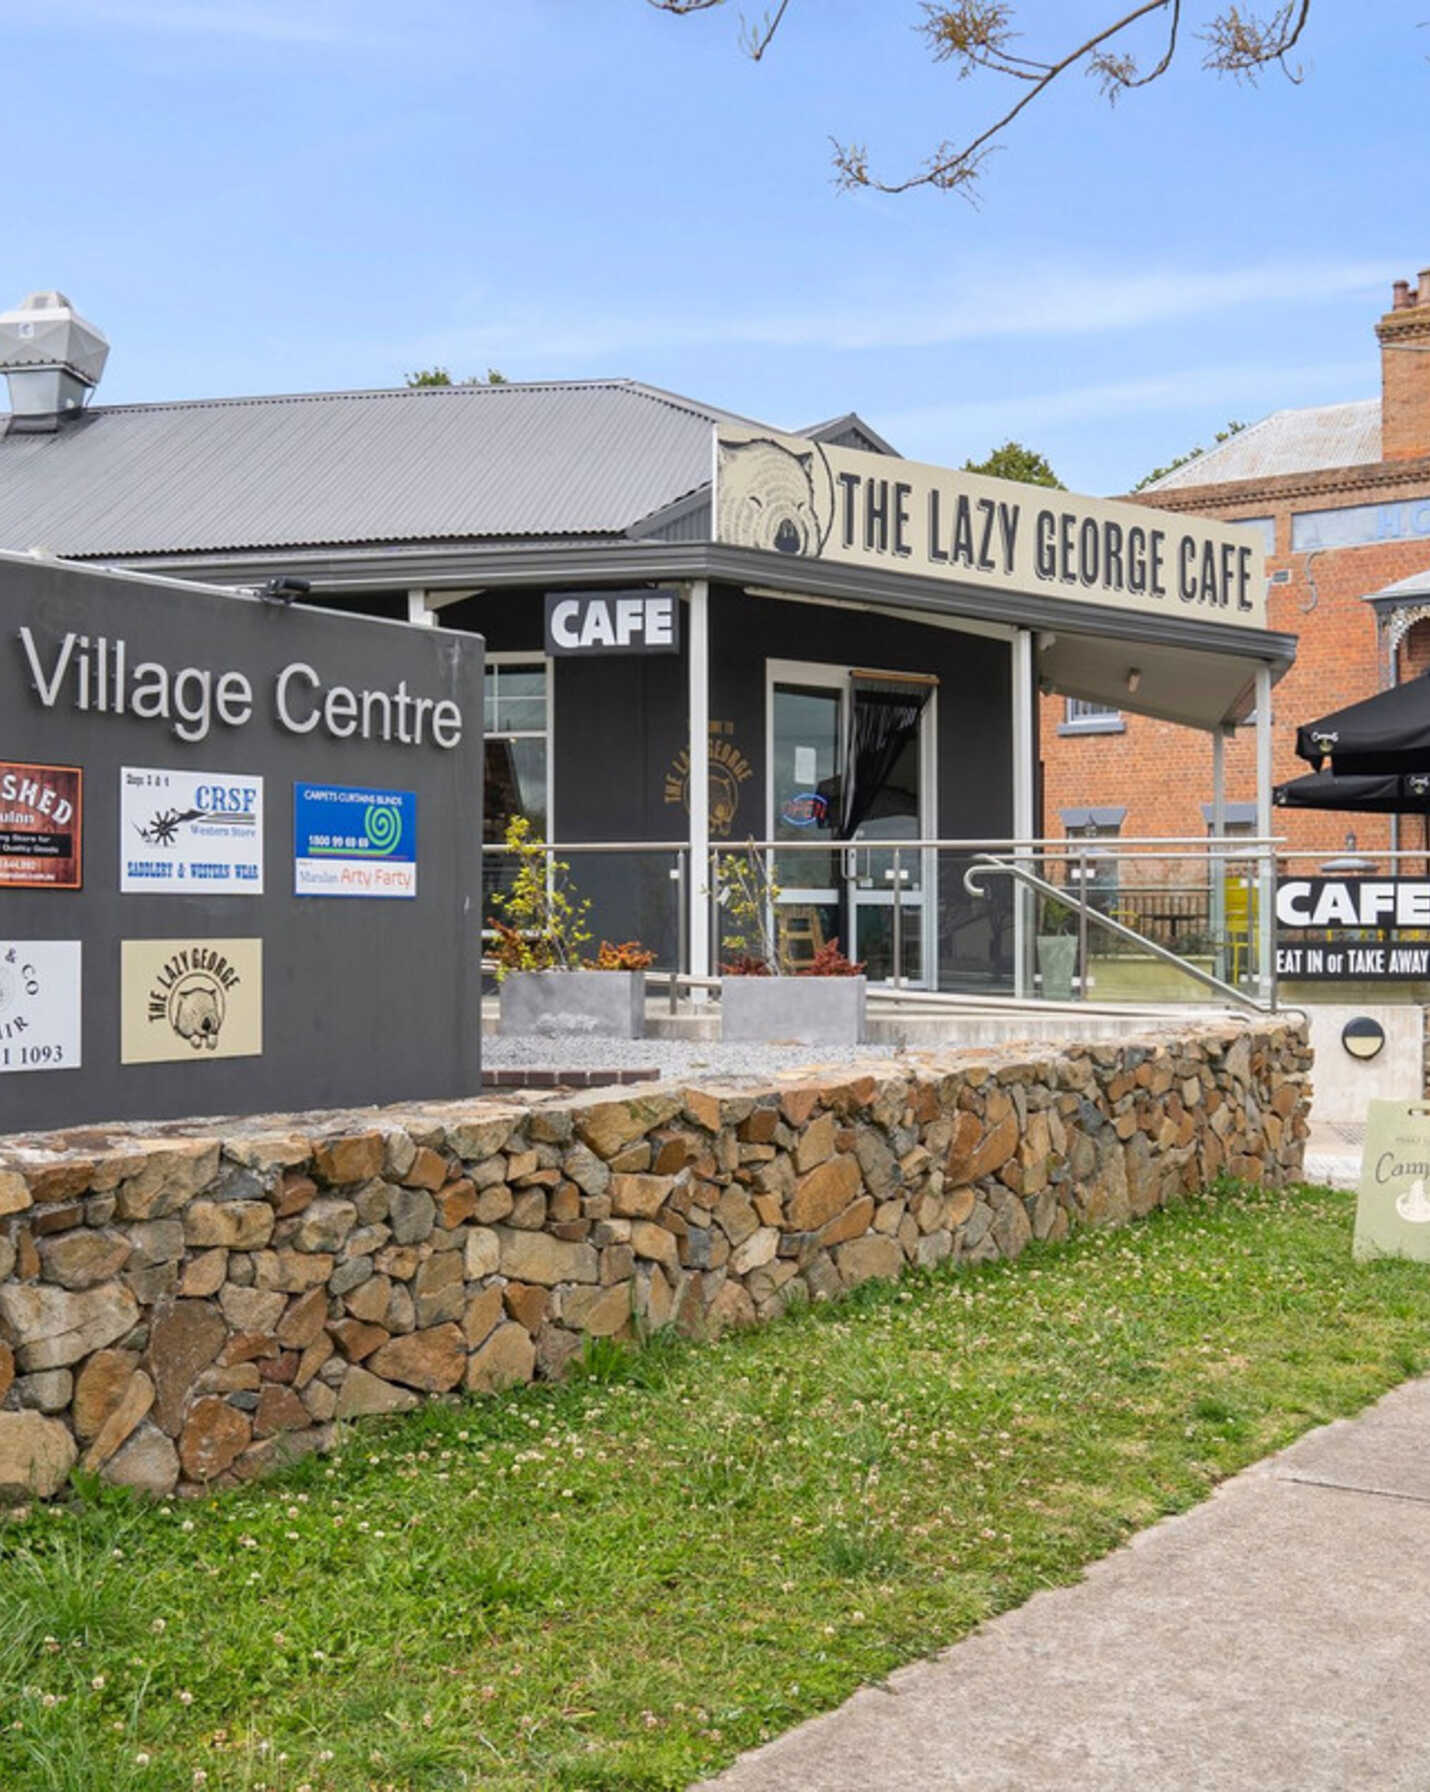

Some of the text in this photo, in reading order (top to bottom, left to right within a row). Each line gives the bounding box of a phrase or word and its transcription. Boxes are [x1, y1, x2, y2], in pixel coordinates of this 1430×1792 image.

[837, 472, 1254, 612] THE LAZY GEORGE CAFE
[551, 598, 673, 648] CAFE
[20, 627, 462, 749] Village Centre
[2, 774, 72, 825] SHED
[195, 785, 256, 812] CRSF
[304, 790, 402, 806] CARPETS CURTAINS BLINDS
[664, 773, 684, 804] THE
[190, 824, 256, 838] Western Store
[127, 861, 258, 880] SADDLERY & WESTERN WEAR
[341, 867, 371, 888] Arty
[375, 867, 411, 890] Farty
[1276, 882, 1430, 926] CAFE
[4, 947, 16, 964] &
[1276, 949, 1429, 973] EAT IN or TAKE AWAY
[148, 947, 240, 1022] THE LAZY GEORGE
[21, 1044, 63, 1064] 1093
